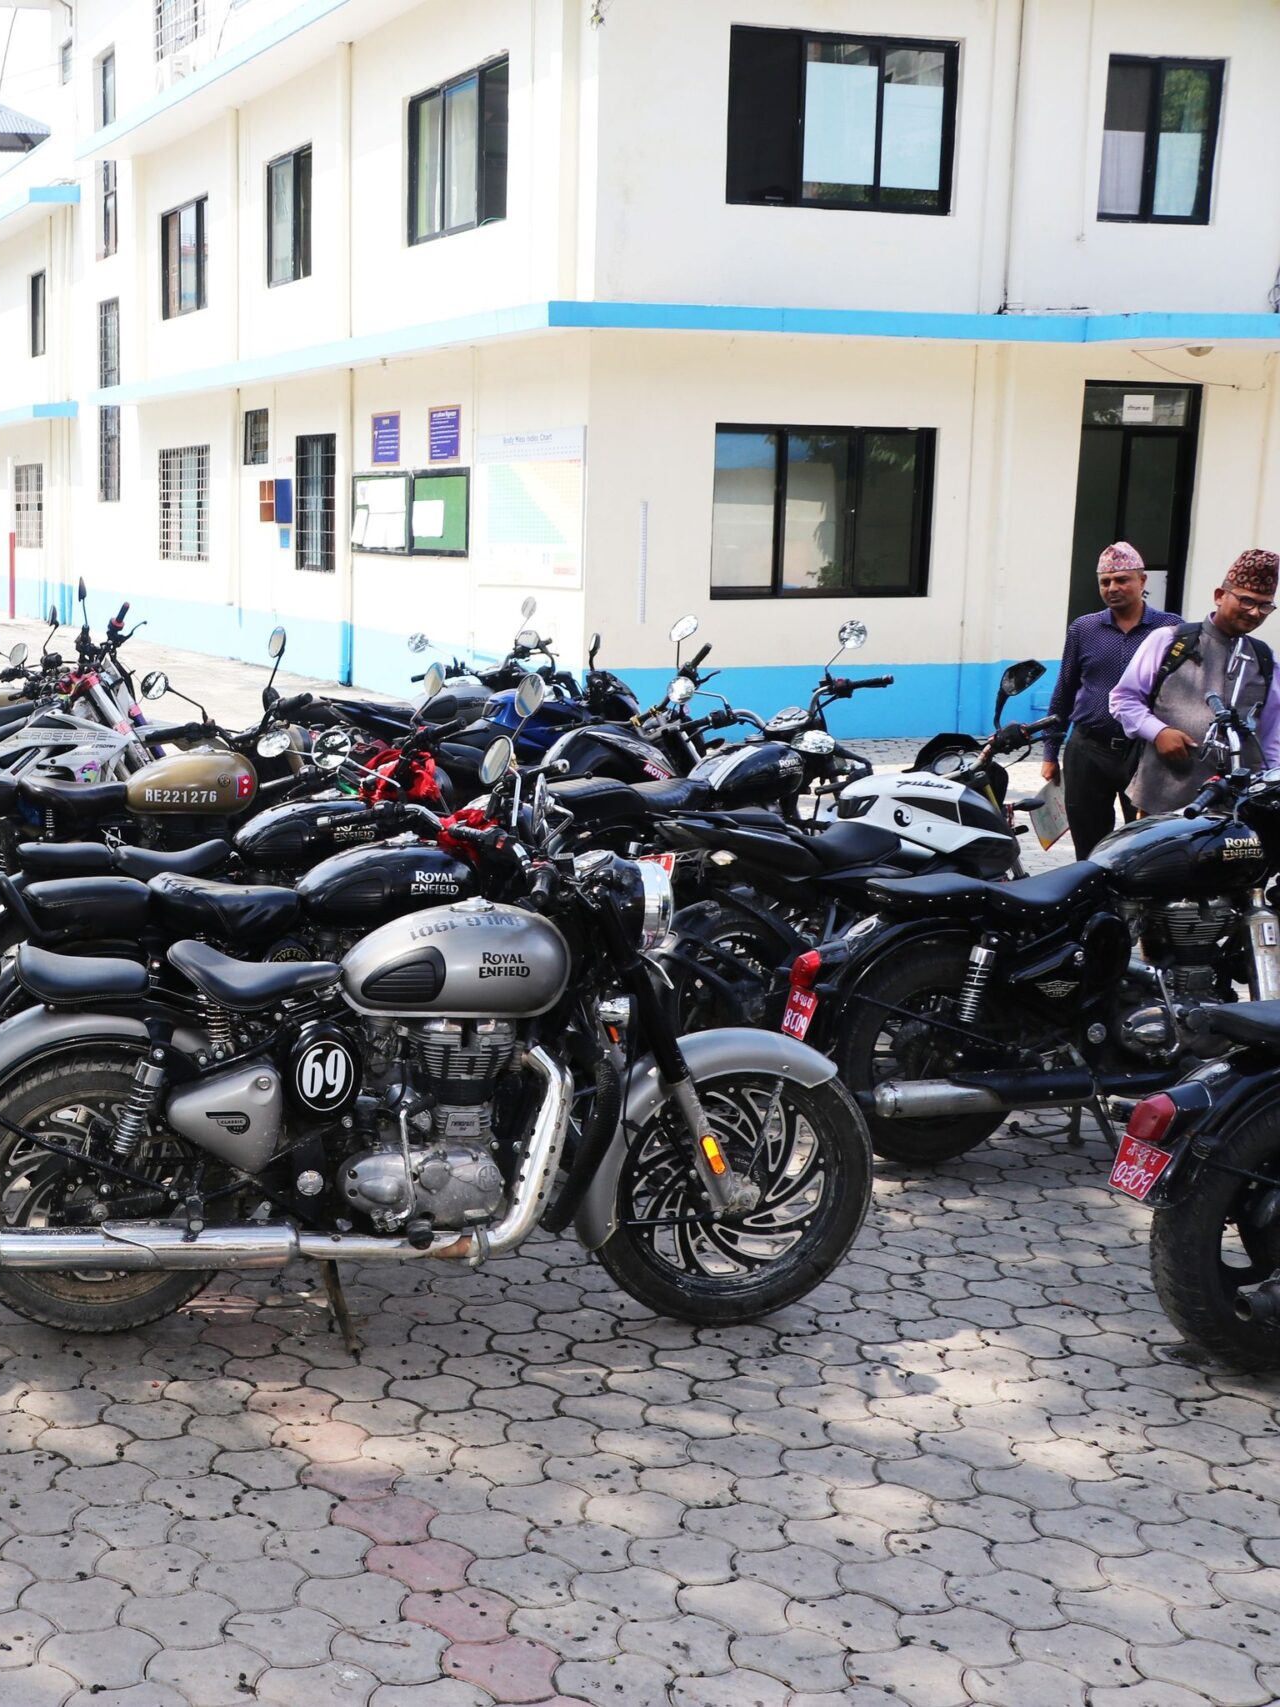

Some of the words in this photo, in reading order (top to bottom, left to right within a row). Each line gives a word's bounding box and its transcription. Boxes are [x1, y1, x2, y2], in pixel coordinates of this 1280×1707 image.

[145, 788, 218, 803] RE221276
[1224, 838, 1261, 849] ROYAL
[415, 870, 456, 883] ROYAL
[410, 883, 460, 895] ENFIELD
[482, 952, 524, 965] ROYAL
[479, 966, 531, 978] ENFIELD
[302, 1049, 346, 1099] 69
